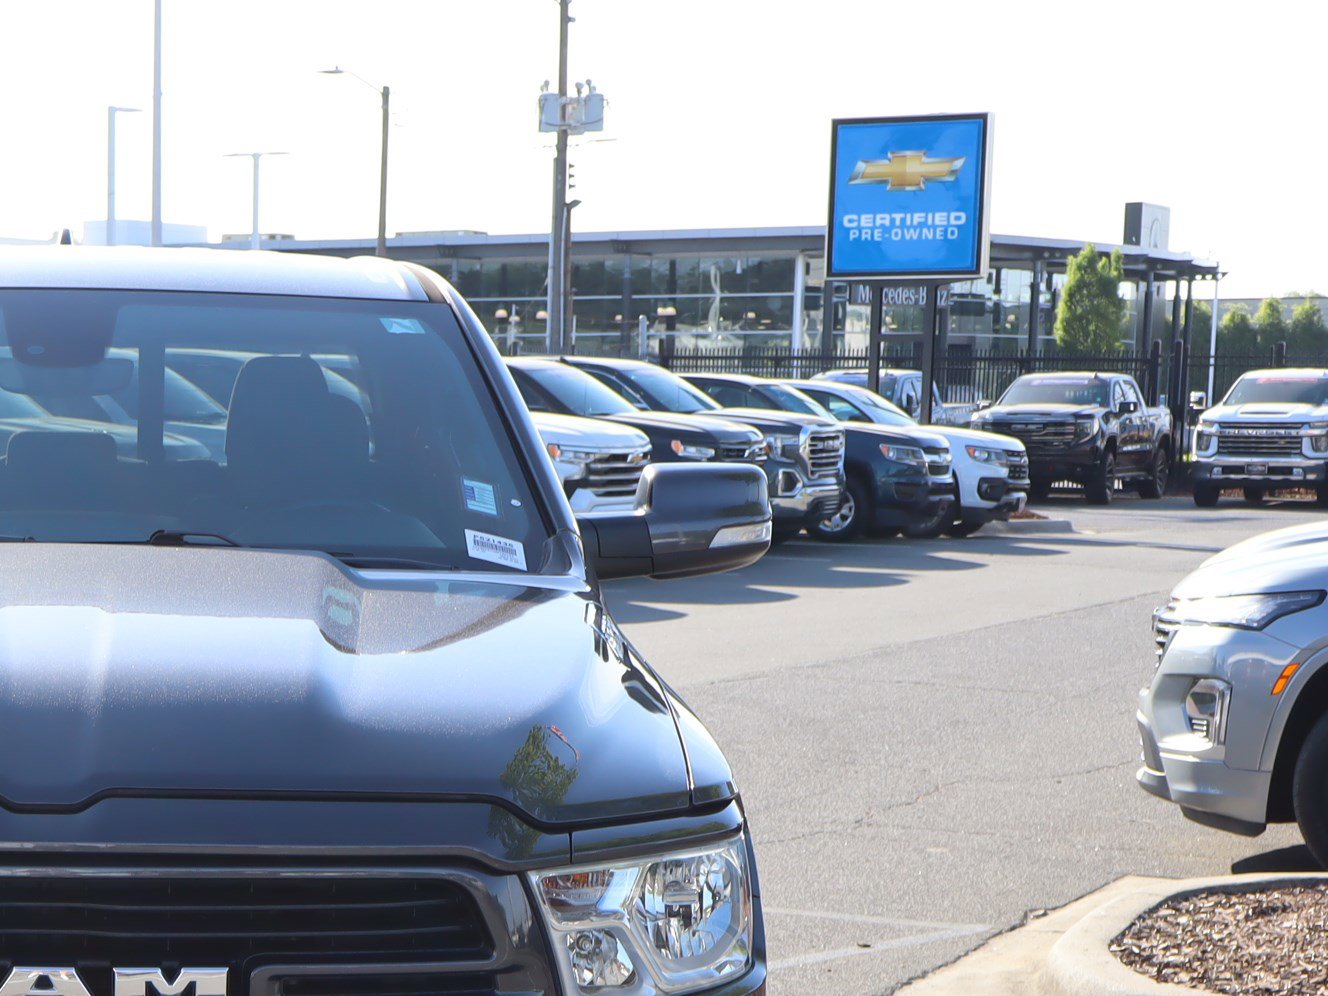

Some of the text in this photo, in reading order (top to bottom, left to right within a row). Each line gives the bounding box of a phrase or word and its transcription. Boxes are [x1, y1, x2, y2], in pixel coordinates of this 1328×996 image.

[843, 211, 967, 228] CERTIFIED
[849, 227, 959, 241] PRE-OWNED
[857, 284, 947, 305] Mcedes-Bz
